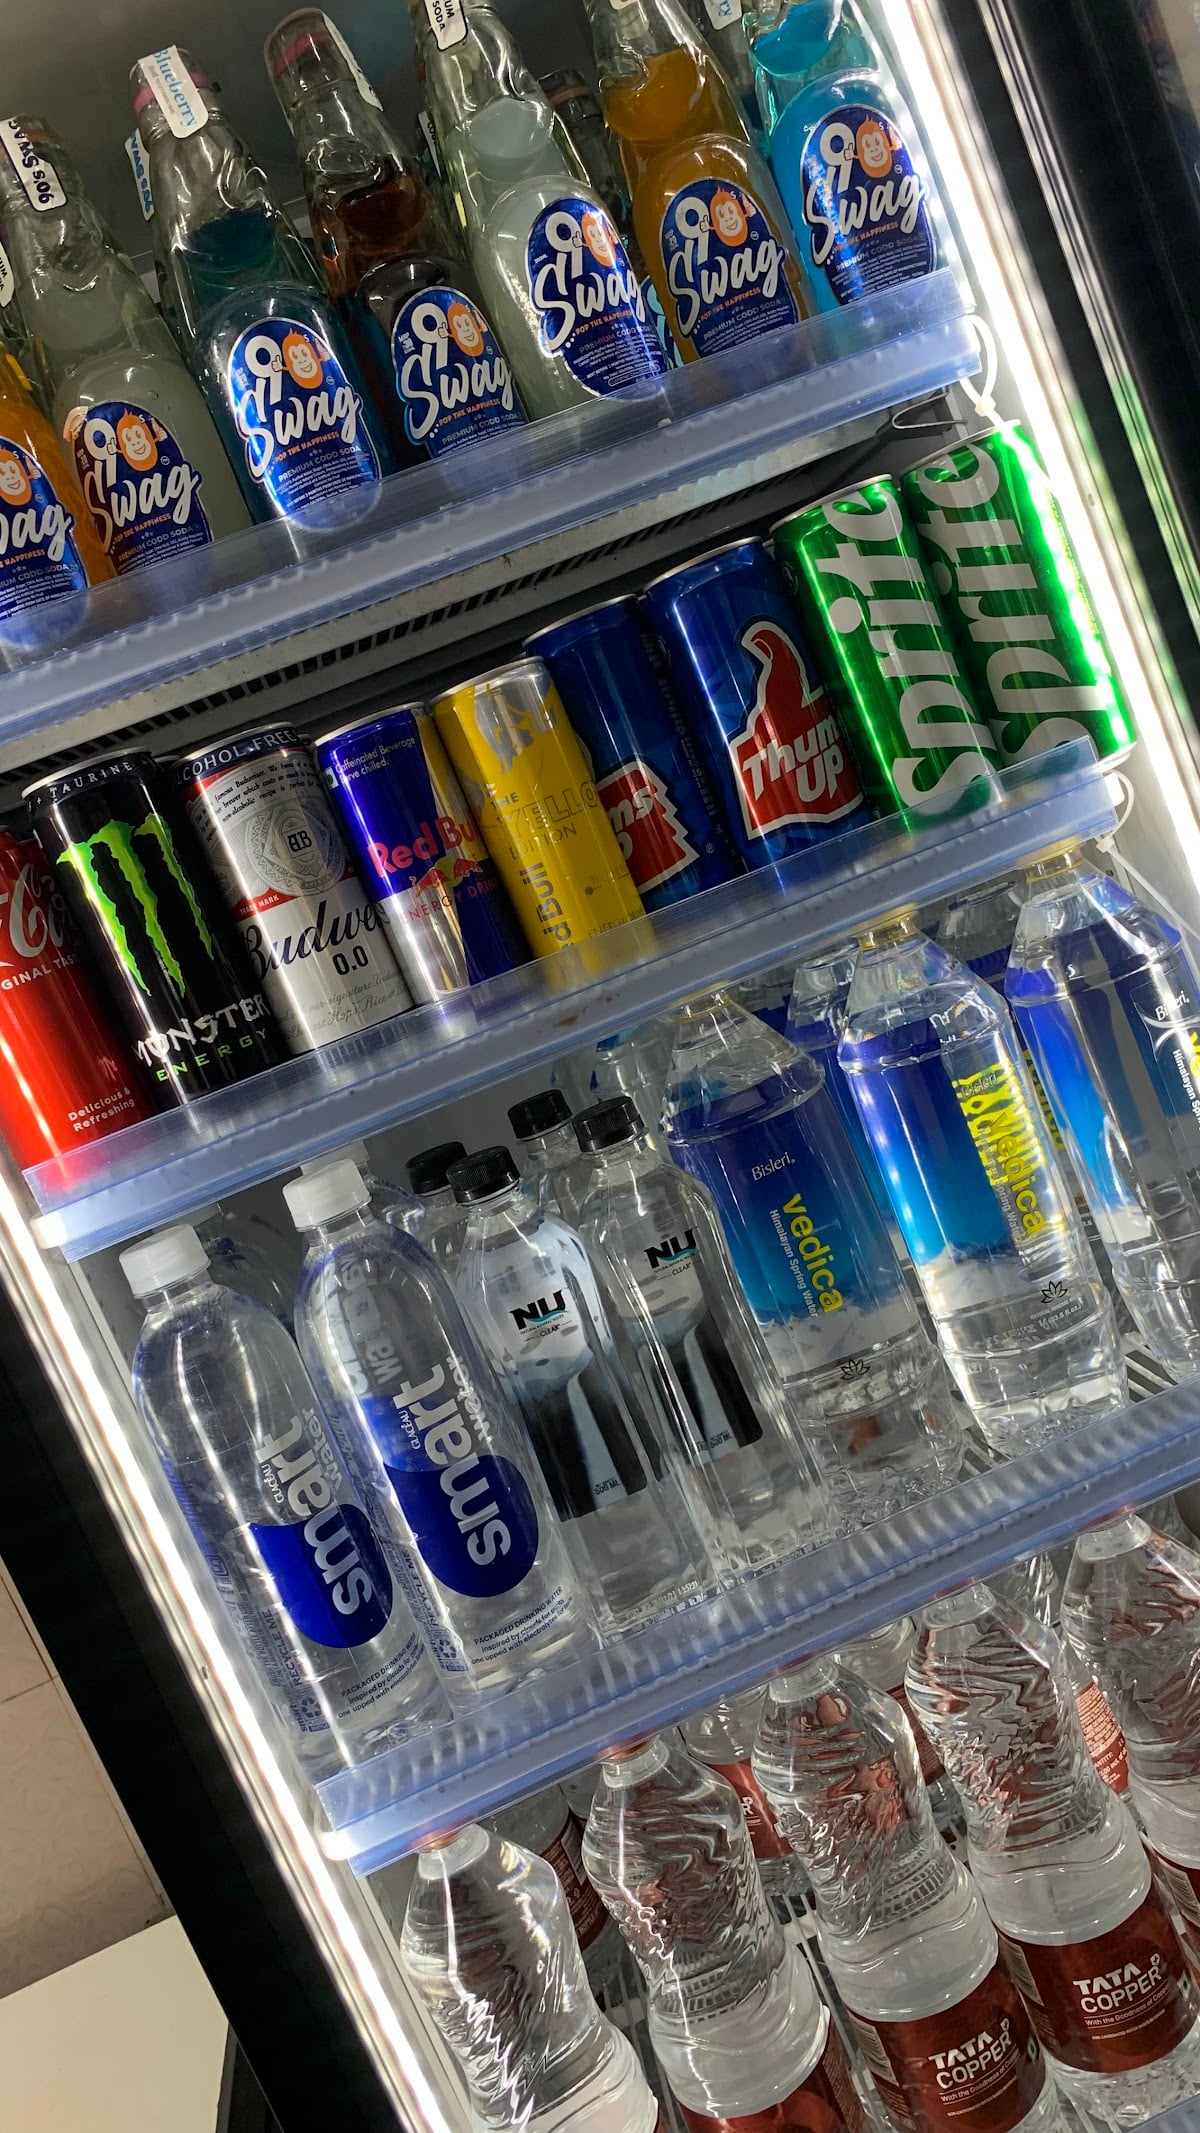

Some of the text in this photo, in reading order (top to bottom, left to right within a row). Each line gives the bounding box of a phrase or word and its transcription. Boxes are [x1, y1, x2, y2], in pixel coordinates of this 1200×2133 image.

[432, 1, 446, 32] SODA
[152, 49, 198, 128] Blueberry
[806, 166, 926, 265] Swag
[836, 252, 870, 272] PREMIUM
[534, 252, 646, 350] Swag
[669, 239, 783, 336] Swag
[590, 318, 603, 330] THE
[703, 299, 781, 341] PREMIUM CODD SODA
[401, 343, 513, 440] Swag
[240, 378, 360, 478] Swag
[302, 432, 340, 450] HAPPINESS
[442, 425, 478, 445] PREMIUM
[478, 416, 501, 429] CODD
[279, 445, 361, 482] PREMIUM CODD SODA
[84, 460, 199, 554] Swag
[4, 549, 46, 567] HAPPINESS
[914, 443, 1108, 770] Sprite
[815, 490, 998, 815] Sprite
[335, 748, 379, 774] Caffeinated
[379, 737, 416, 756] Beverage
[743, 715, 841, 800] Thum
[50, 762, 132, 798] TAURINE
[490, 792, 519, 811] THE
[496, 781, 601, 839] YELLO
[367, 821, 439, 878] Red
[509, 822, 578, 860] EDITION
[258, 894, 281, 908] MARK
[332, 945, 369, 976] 0.0
[135, 993, 271, 1068] MONSTER
[156, 1027, 268, 1082] ENERGY
[1172, 1049, 1197, 1101] Himalayan
[68, 1086, 131, 1122] Delicious &
[73, 1097, 136, 1133] Refreshing
[643, 1229, 698, 1270] NU
[769, 1208, 820, 1318] Himalayan Spring Water
[509, 1289, 567, 1331] NU
[540, 1323, 561, 1337] CLEAR
[302, 1406, 343, 1491] water
[392, 1362, 512, 1568] smart
[256, 1415, 373, 1616] smart
[261, 1608, 277, 1630] ME
[474, 1625, 514, 1645] PACKAGED
[515, 1603, 546, 1629] DRINKING
[546, 1586, 562, 1606] WATER
[471, 1657, 484, 1665] one
[485, 1648, 507, 1661] upped
[508, 1640, 524, 1651] with
[511, 1632, 521, 1642] by
[272, 1631, 303, 1686] RECYCLE
[341, 1672, 380, 1697] PACKAGED
[377, 1679, 386, 1689] by
[1073, 1962, 1142, 1996] TATA
[1081, 1965, 1162, 2014] COPPER
[1085, 2019, 1102, 2027] With
[1115, 2003, 1147, 2021] Goodness
[928, 2031, 994, 2070] TATA
[936, 2031, 1012, 2089] COPPER
[941, 2093, 958, 2102] With
[958, 2089, 970, 2097] the
